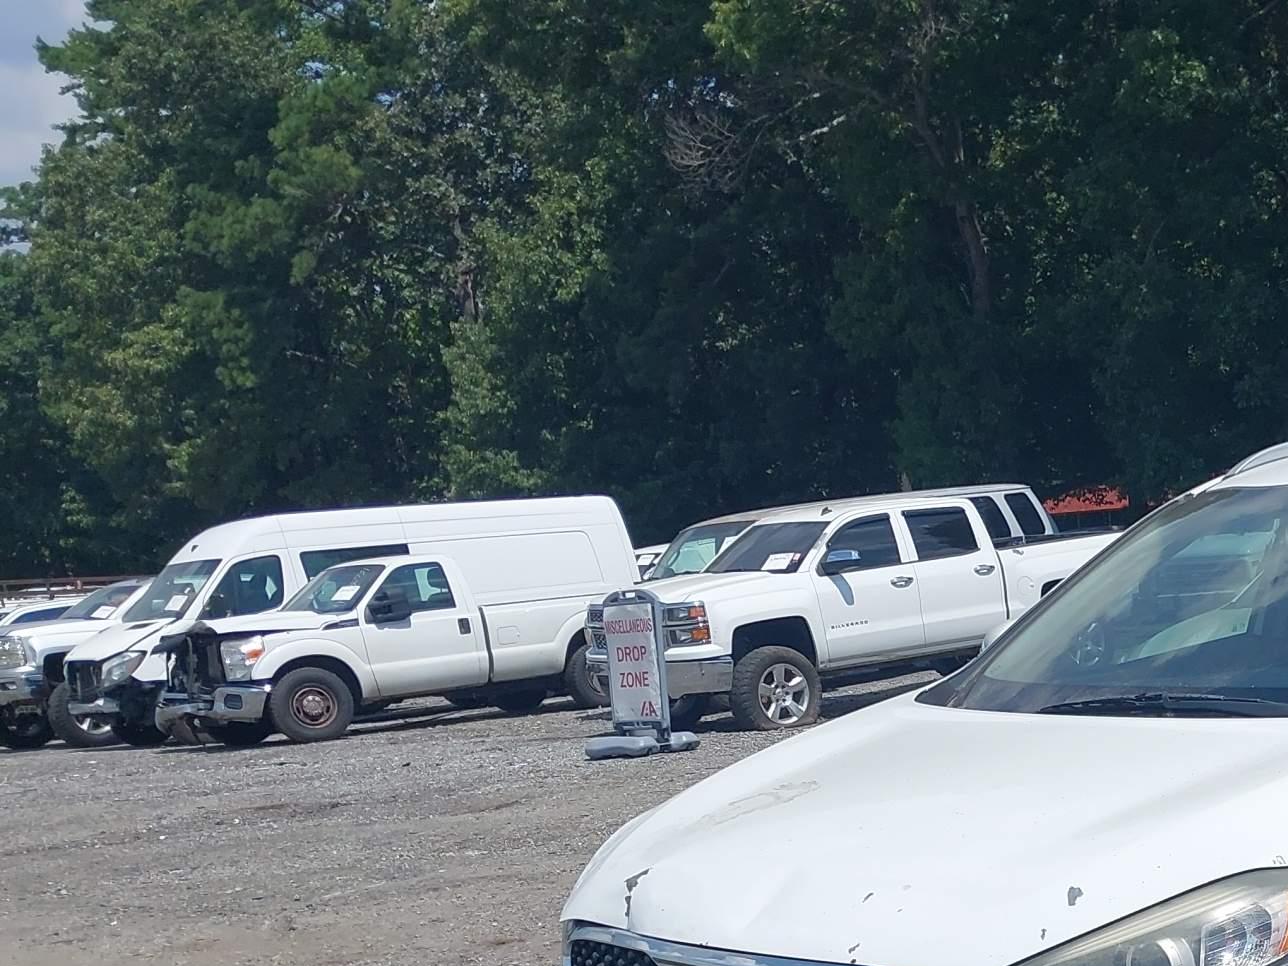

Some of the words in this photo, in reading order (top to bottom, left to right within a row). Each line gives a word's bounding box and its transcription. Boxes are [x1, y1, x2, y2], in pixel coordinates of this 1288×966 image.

[605, 617, 653, 635] MISCELLANEOUS
[616, 645, 647, 663] DROP
[620, 671, 650, 688] ZONE
